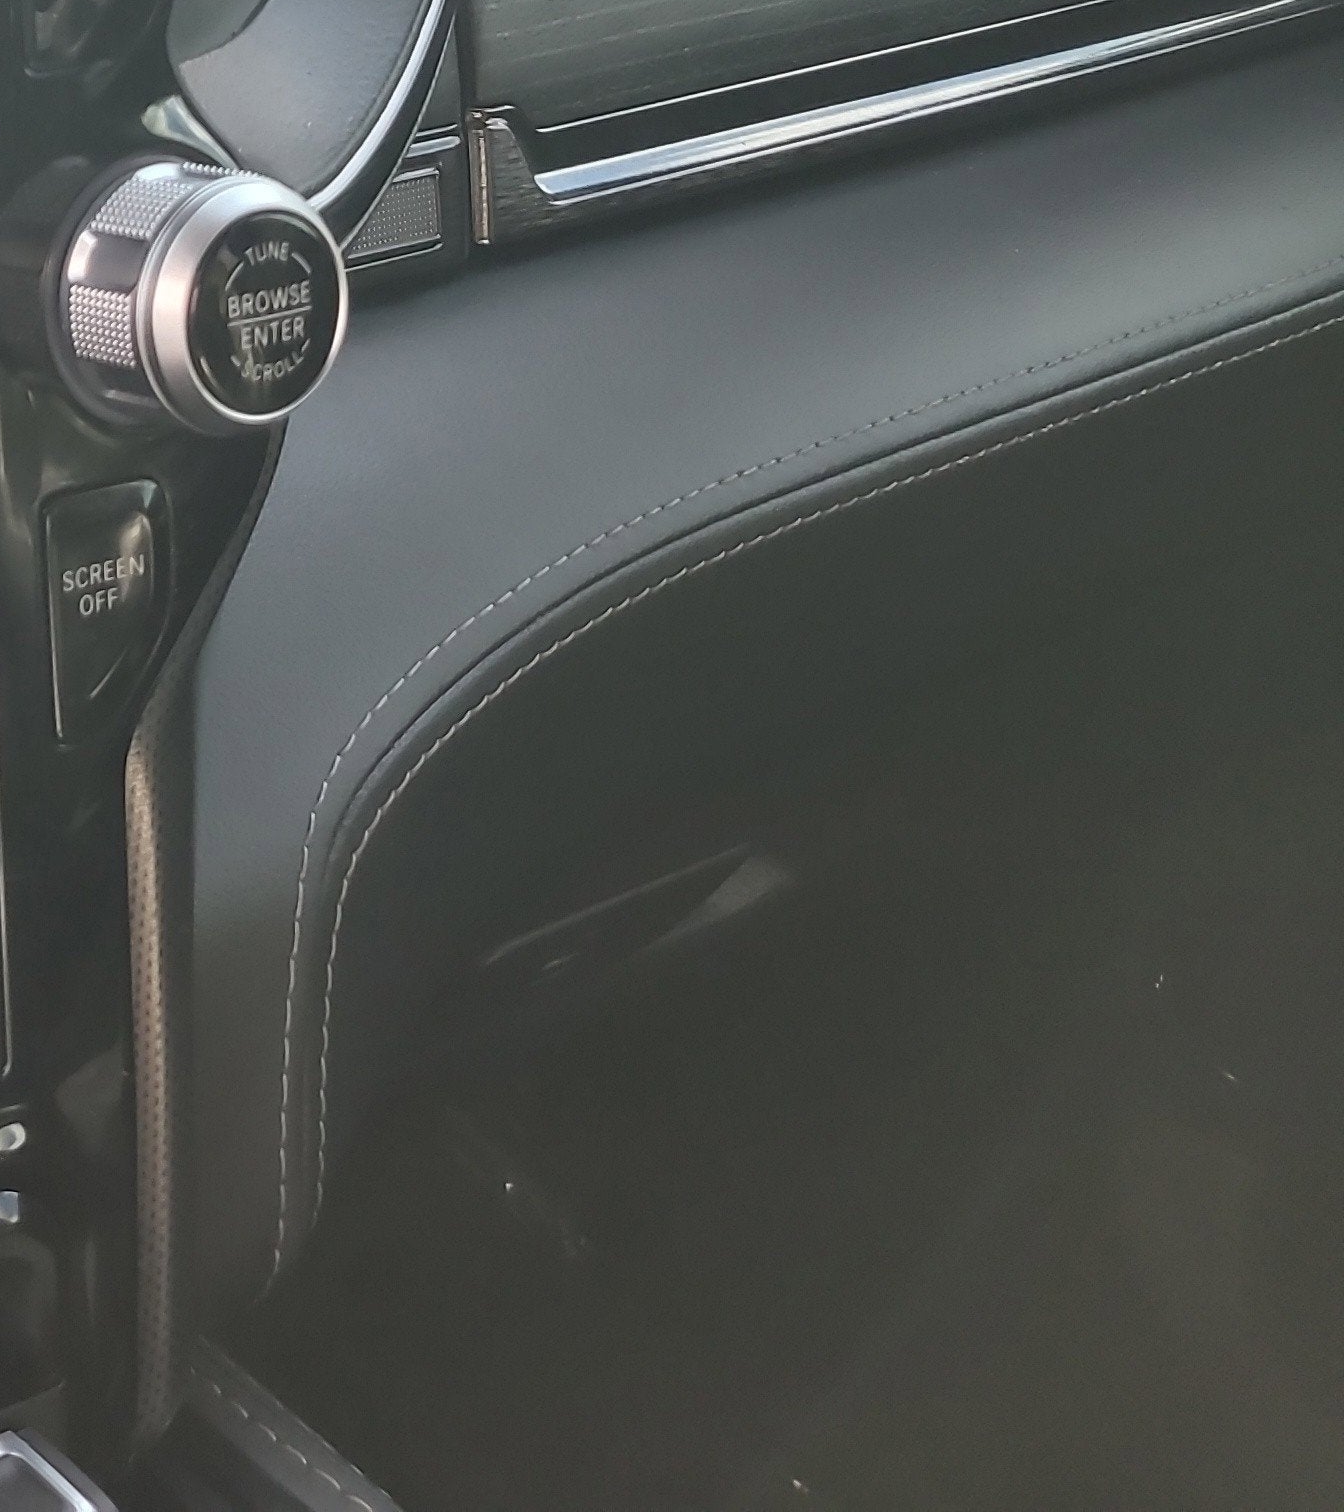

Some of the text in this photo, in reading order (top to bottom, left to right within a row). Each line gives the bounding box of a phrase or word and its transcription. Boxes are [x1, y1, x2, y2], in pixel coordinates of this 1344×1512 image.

[244, 241, 290, 266] TUNE
[228, 280, 311, 318] BROWSE
[241, 316, 305, 350] ENTER
[62, 554, 145, 592] SCREEN
[79, 587, 118, 616] OFF
